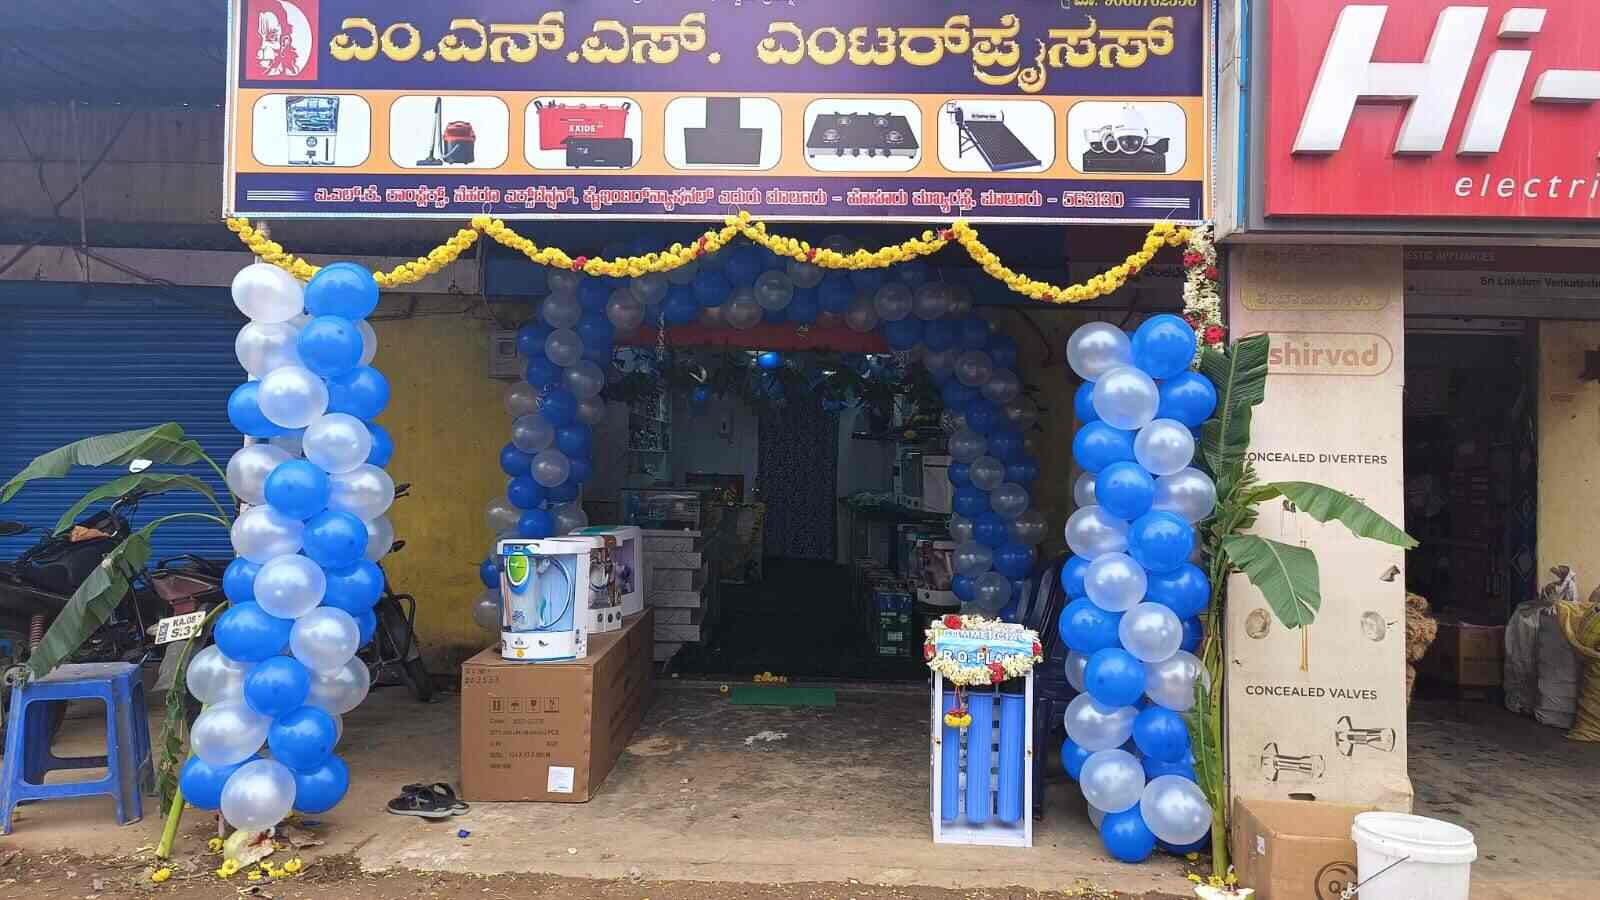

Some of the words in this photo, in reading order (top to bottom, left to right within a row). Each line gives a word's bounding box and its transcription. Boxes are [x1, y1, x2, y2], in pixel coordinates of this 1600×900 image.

[1062, 190, 1125, 208] 563130
[1269, 342, 1378, 367] shirvad
[1319, 453, 1388, 465] DIVERTERS
[1245, 685, 1326, 698] CONCEALED
[1329, 688, 1378, 700] VALVES
